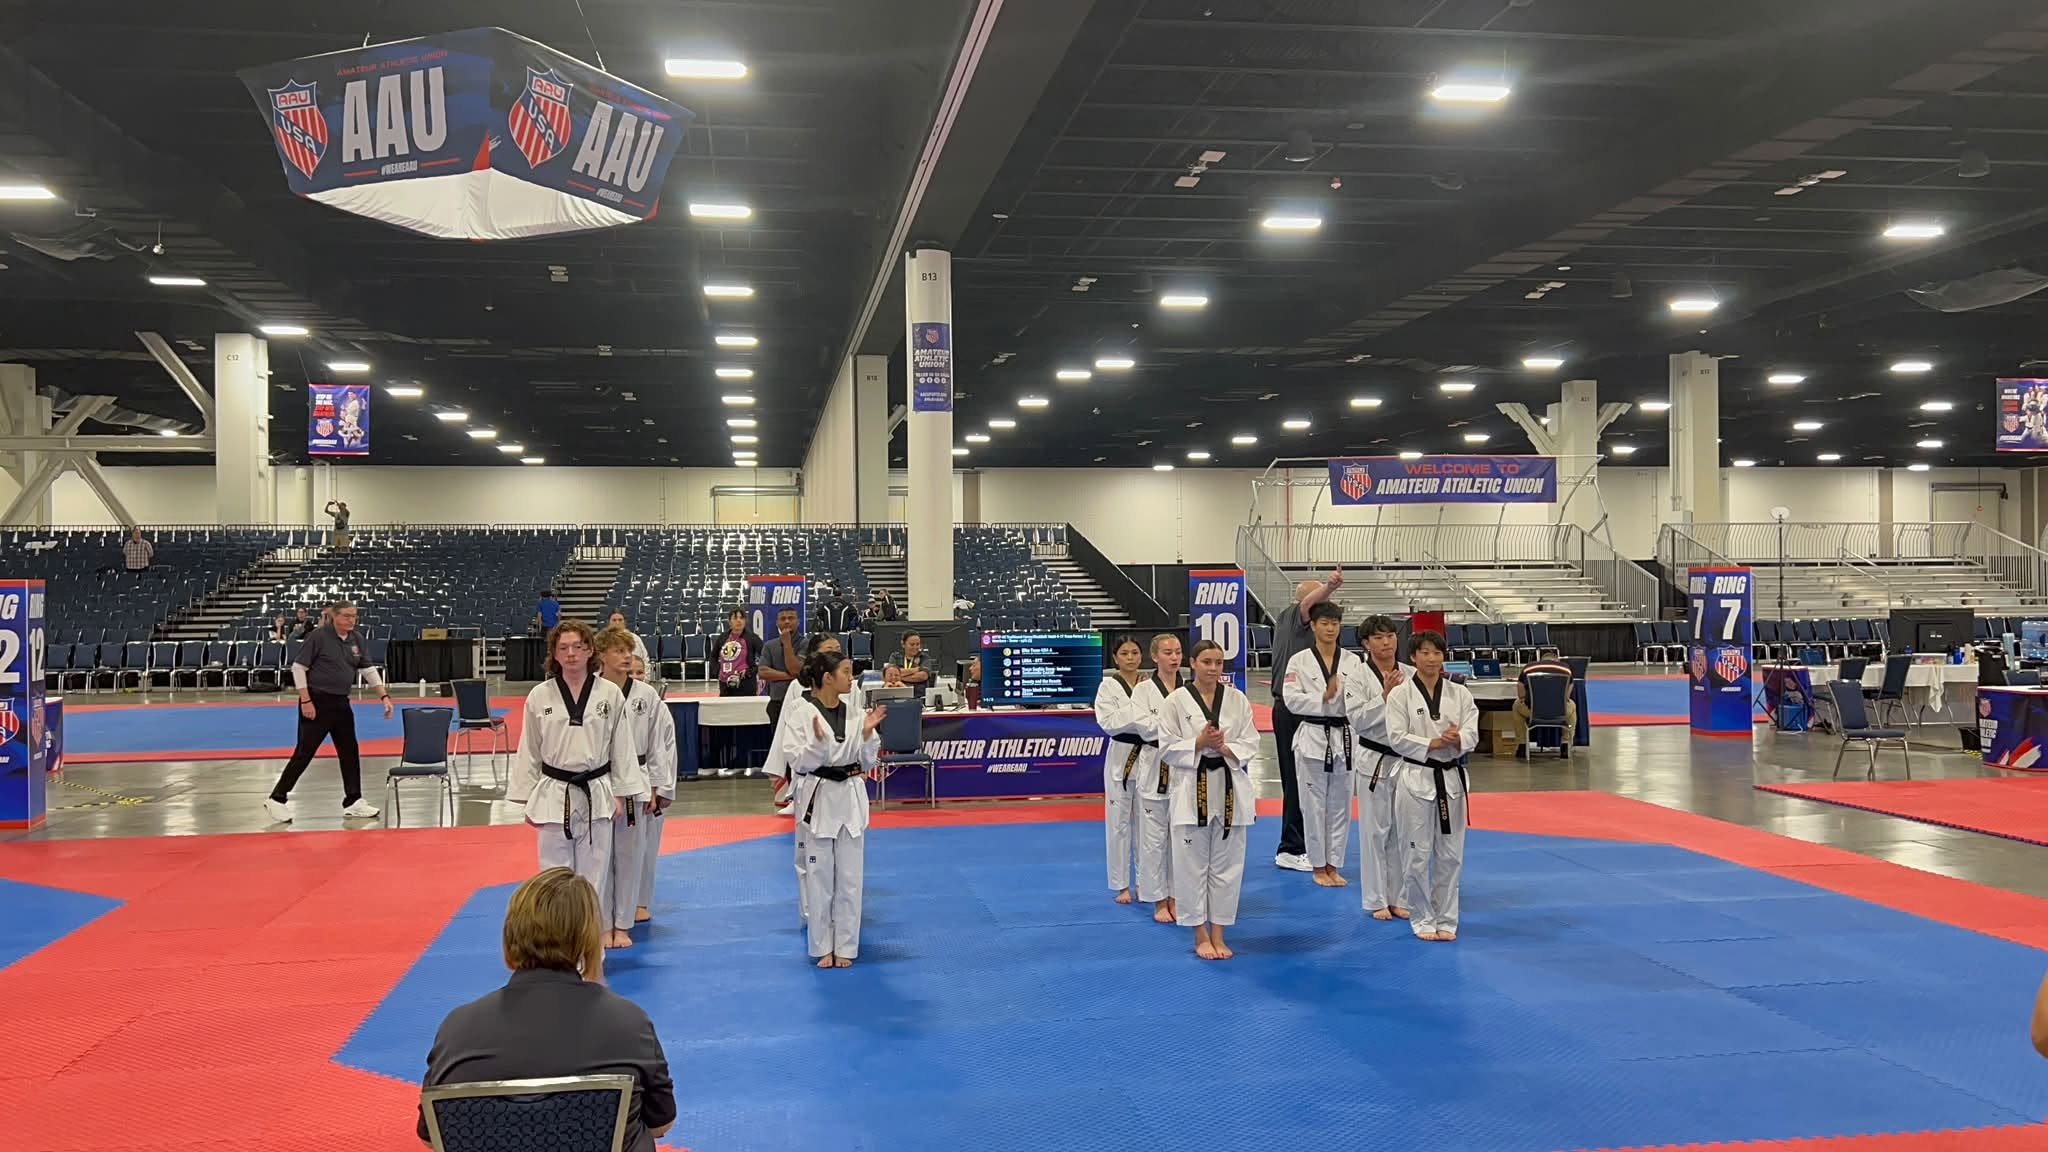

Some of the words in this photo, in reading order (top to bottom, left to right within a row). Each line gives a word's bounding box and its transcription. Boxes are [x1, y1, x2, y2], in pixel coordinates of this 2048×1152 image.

[278, 92, 308, 105] AAU
[534, 79, 564, 99] AAU
[342, 66, 447, 163] AAU
[528, 97, 555, 150] USA
[280, 115, 317, 154] USA
[572, 101, 664, 192] AAU
[921, 272, 937, 281] B13
[1405, 464, 1489, 475] WELCOME
[1497, 464, 1520, 474] TO
[1376, 478, 1439, 495] AMATEUR
[1442, 478, 1501, 494] ATHLETIC
[1504, 478, 1545, 494] UNION
[750, 586, 766, 605] RING
[771, 586, 801, 605] RING
[1194, 582, 1239, 605] RING
[1690, 577, 1707, 594] RING
[1713, 576, 1747, 594] RING
[1693, 599, 1705, 640] 7
[1720, 599, 1741, 640] 7
[1195, 612, 1239, 660] 10
[0, 629, 20, 684] 2
[29, 627, 45, 682] 12
[922, 739, 986, 760] MATEUR
[987, 738, 1054, 759] ATHLETIC
[1058, 737, 1104, 757] UNION
[987, 763, 1028, 774] #WEAREAAU
